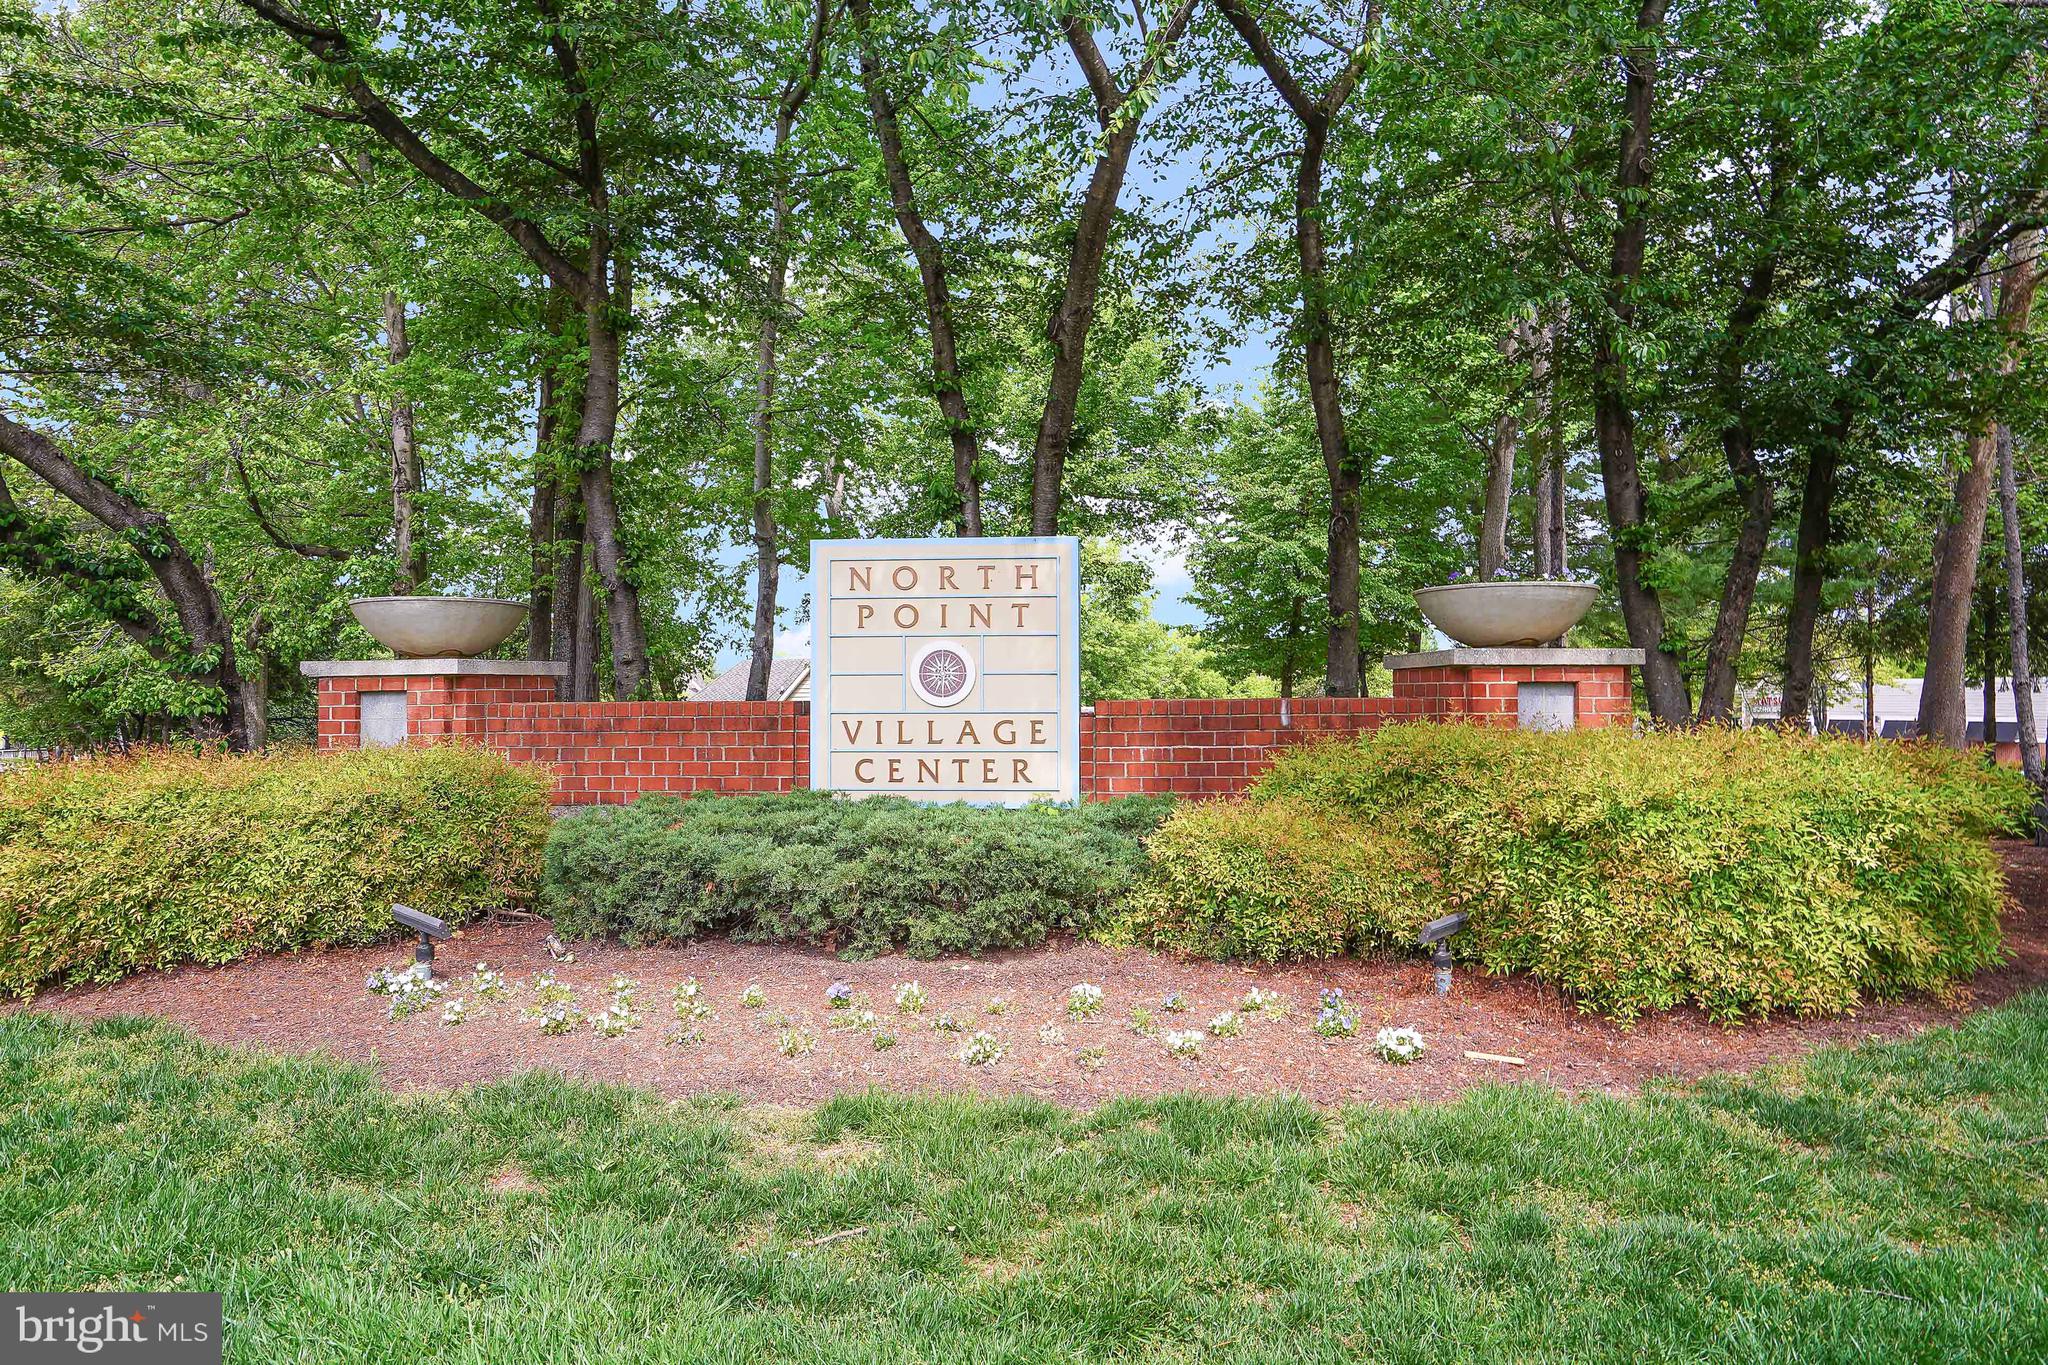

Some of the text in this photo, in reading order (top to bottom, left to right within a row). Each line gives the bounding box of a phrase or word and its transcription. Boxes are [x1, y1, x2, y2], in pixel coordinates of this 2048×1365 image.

[849, 564, 1039, 591] NORTH
[857, 603, 1030, 629] POINT
[842, 719, 1047, 745] VILLAGE
[854, 758, 1033, 784] CENTER
